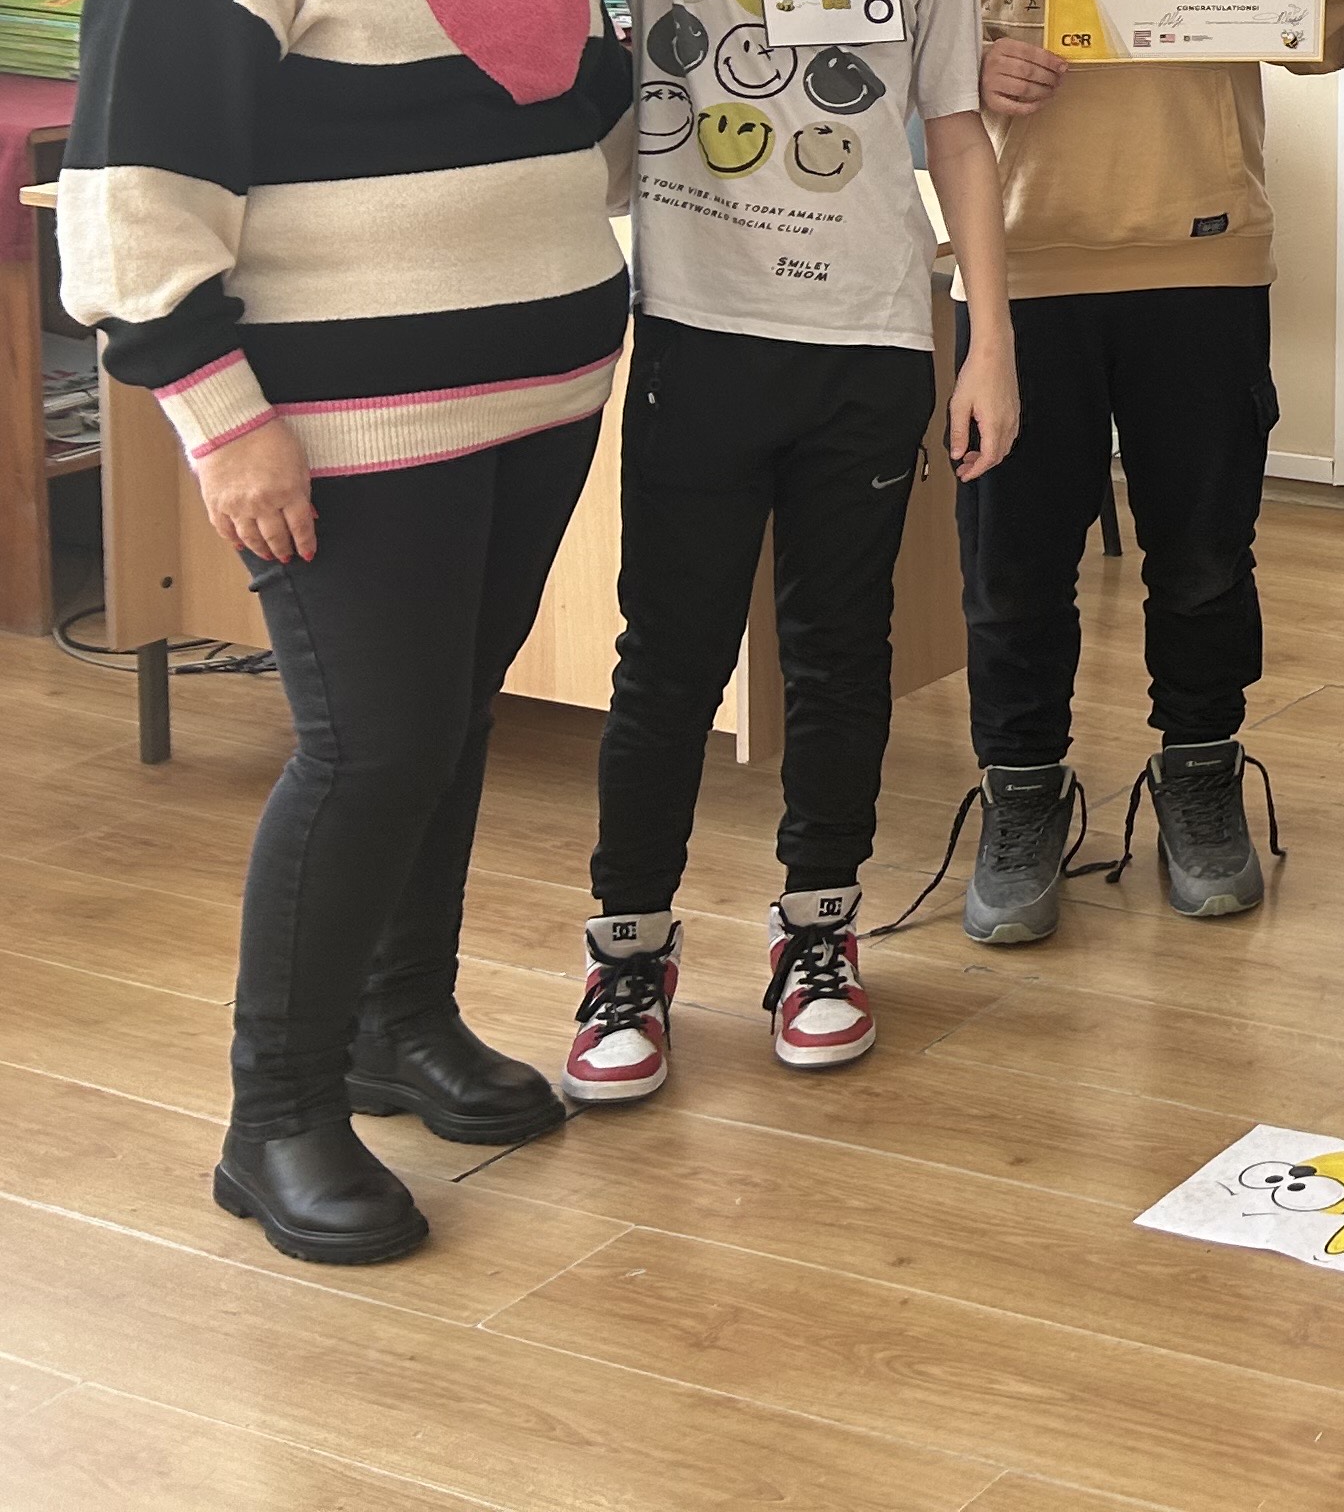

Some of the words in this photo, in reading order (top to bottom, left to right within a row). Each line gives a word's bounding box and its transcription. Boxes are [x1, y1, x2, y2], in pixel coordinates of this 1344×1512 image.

[653, 177, 684, 192] YOUR
[713, 194, 740, 210] MAKE
[745, 204, 785, 216] TODAY
[732, 217, 772, 231] SOCIAL
[777, 224, 814, 236] CLUB!
[777, 256, 830, 271] SMILEY
